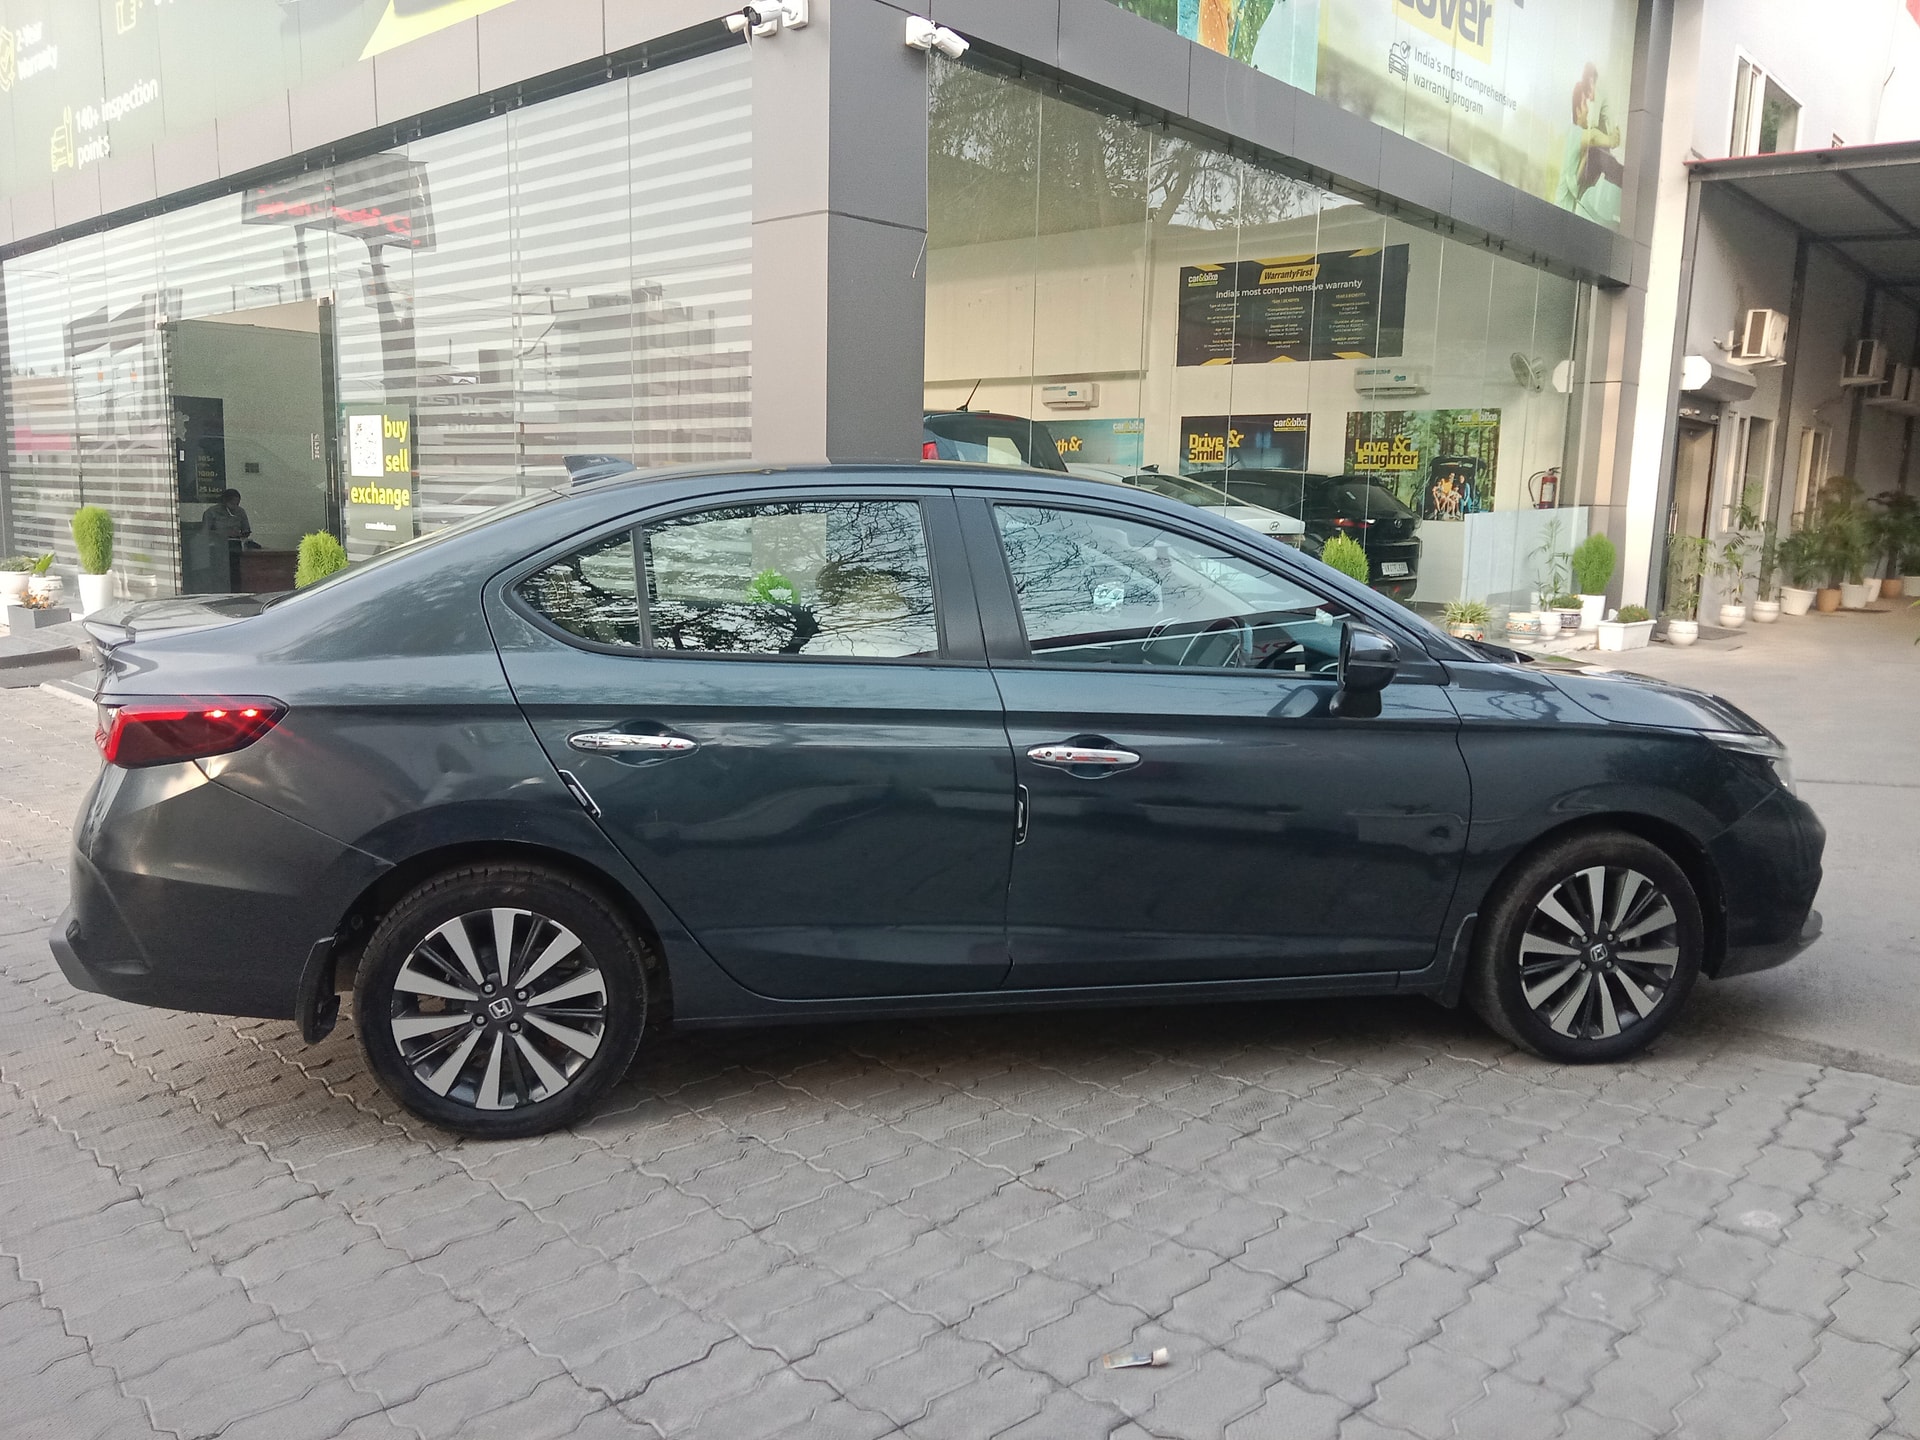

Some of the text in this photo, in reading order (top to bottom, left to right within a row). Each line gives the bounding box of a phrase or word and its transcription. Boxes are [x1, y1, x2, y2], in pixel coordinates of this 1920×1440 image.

[1398, 0, 1492, 47] ver
[1414, 47, 1517, 111] India's most comprehensive
[101, 79, 158, 121] inspection
[1413, 72, 1484, 115] warranty program
[77, 135, 111, 170] points
[1264, 268, 1313, 281] WarrantyFirst
[1216, 289, 1240, 299] Indias
[1241, 288, 1261, 297] most
[1263, 282, 1324, 295] comprehensive
[1325, 279, 1363, 290] warranty
[384, 414, 408, 443] buy
[1189, 429, 1245, 448] Drive &
[1189, 448, 1224, 461] Smile
[1355, 438, 1390, 452] Love
[385, 448, 410, 473] sell
[1356, 451, 1418, 468] Laughter
[350, 481, 410, 511] exchange
